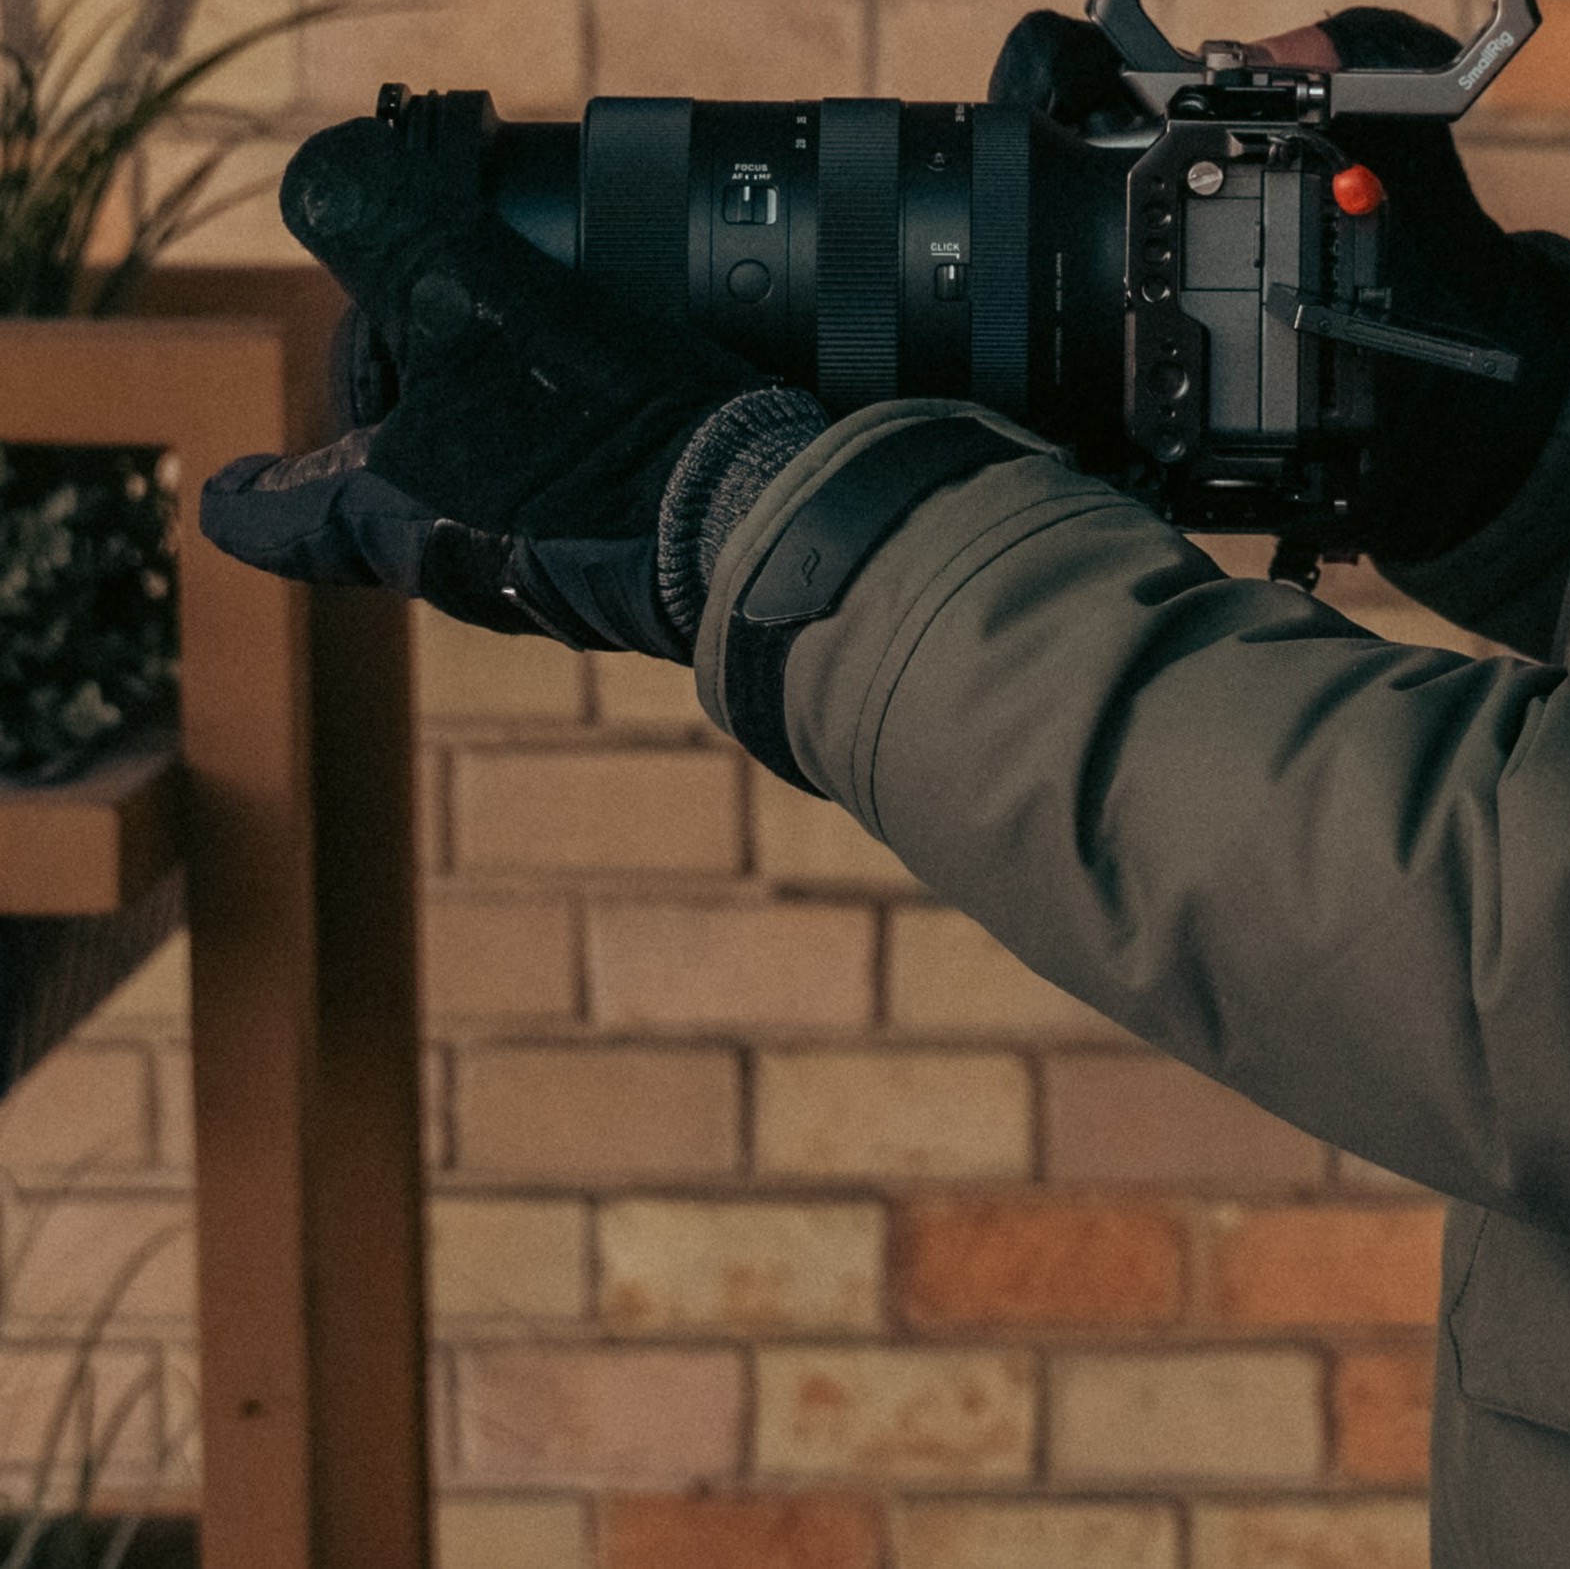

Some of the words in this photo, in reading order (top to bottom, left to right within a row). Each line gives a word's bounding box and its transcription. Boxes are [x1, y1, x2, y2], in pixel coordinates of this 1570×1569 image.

[1458, 31, 1514, 90] SmallRig
[734, 163, 768, 172] FOCUS
[930, 242, 961, 252] CLICK
